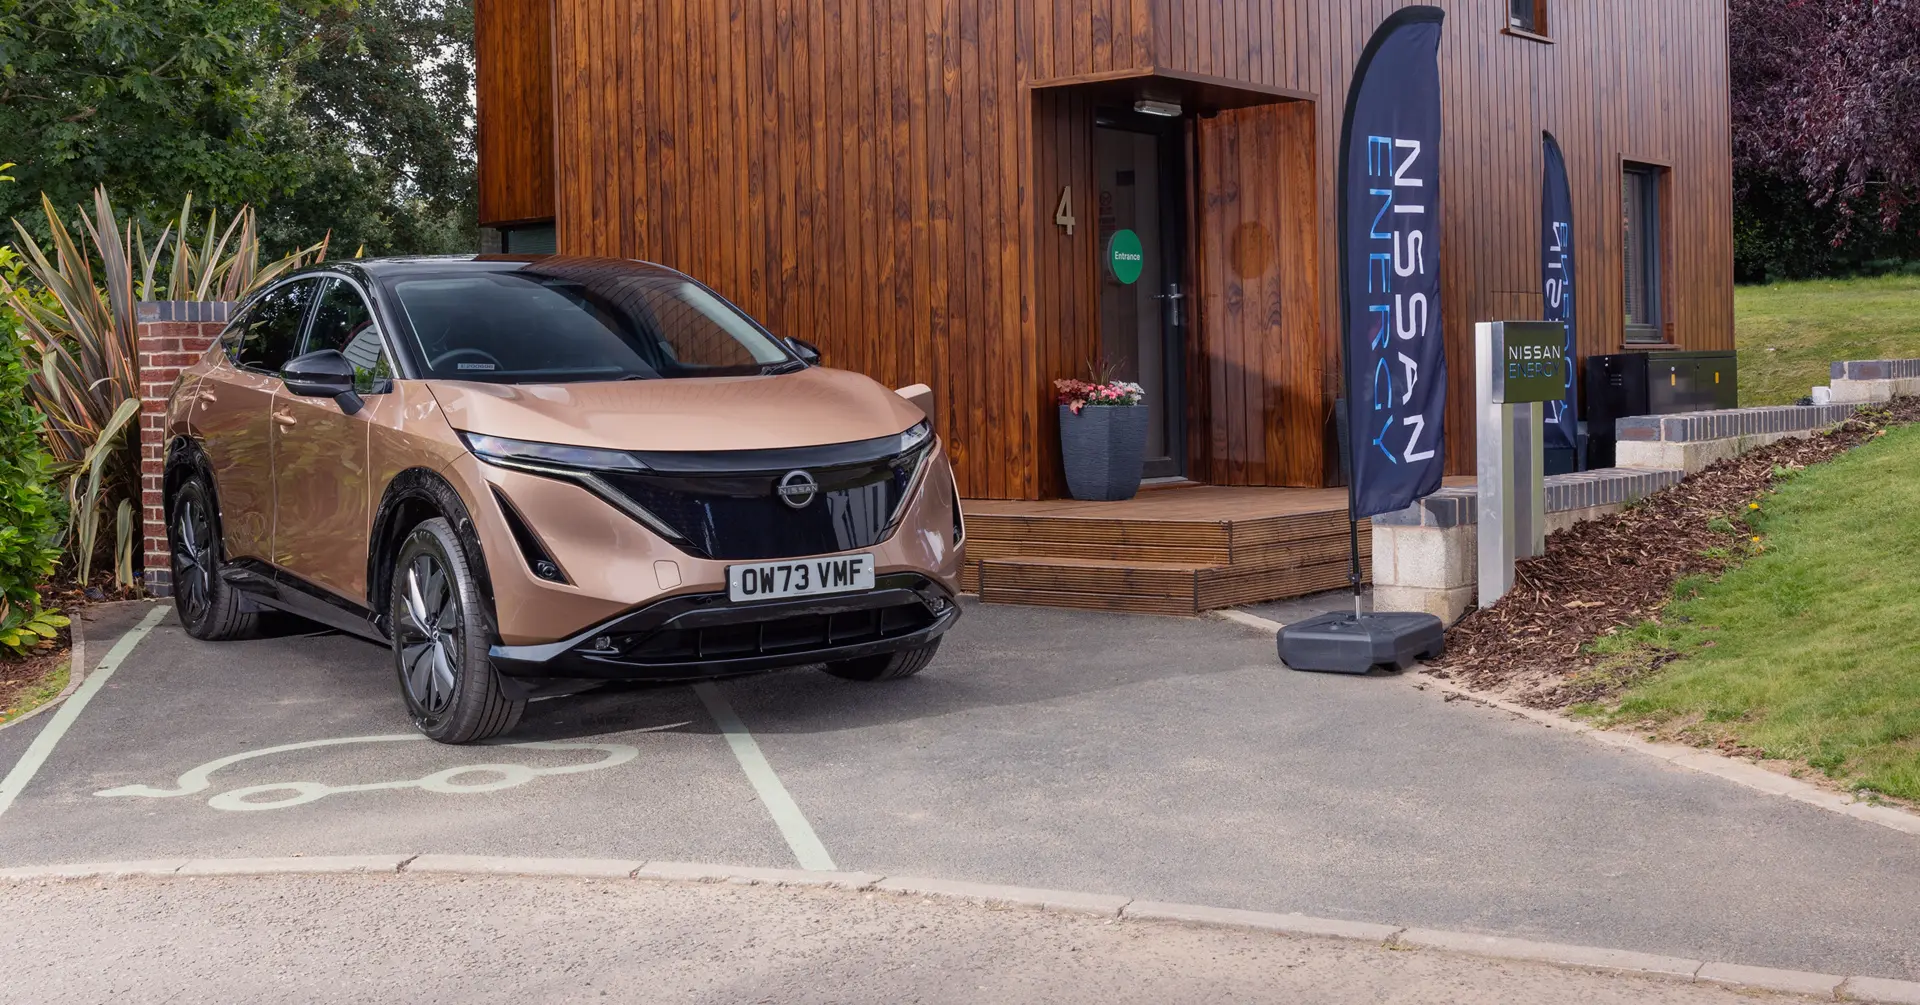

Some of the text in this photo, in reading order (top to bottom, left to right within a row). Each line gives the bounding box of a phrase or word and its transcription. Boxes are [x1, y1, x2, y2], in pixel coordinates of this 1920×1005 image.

[1056, 185, 1075, 235] 4
[1114, 251, 1140, 261] Entrance
[1368, 135, 1397, 464] ENERGY
[1394, 138, 1435, 463] NISSAN
[1509, 345, 1561, 360] NISSAN
[1509, 361, 1560, 379] ENERGY
[779, 485, 817, 495] NISSAN
[742, 558, 863, 595] OW73 VMF
